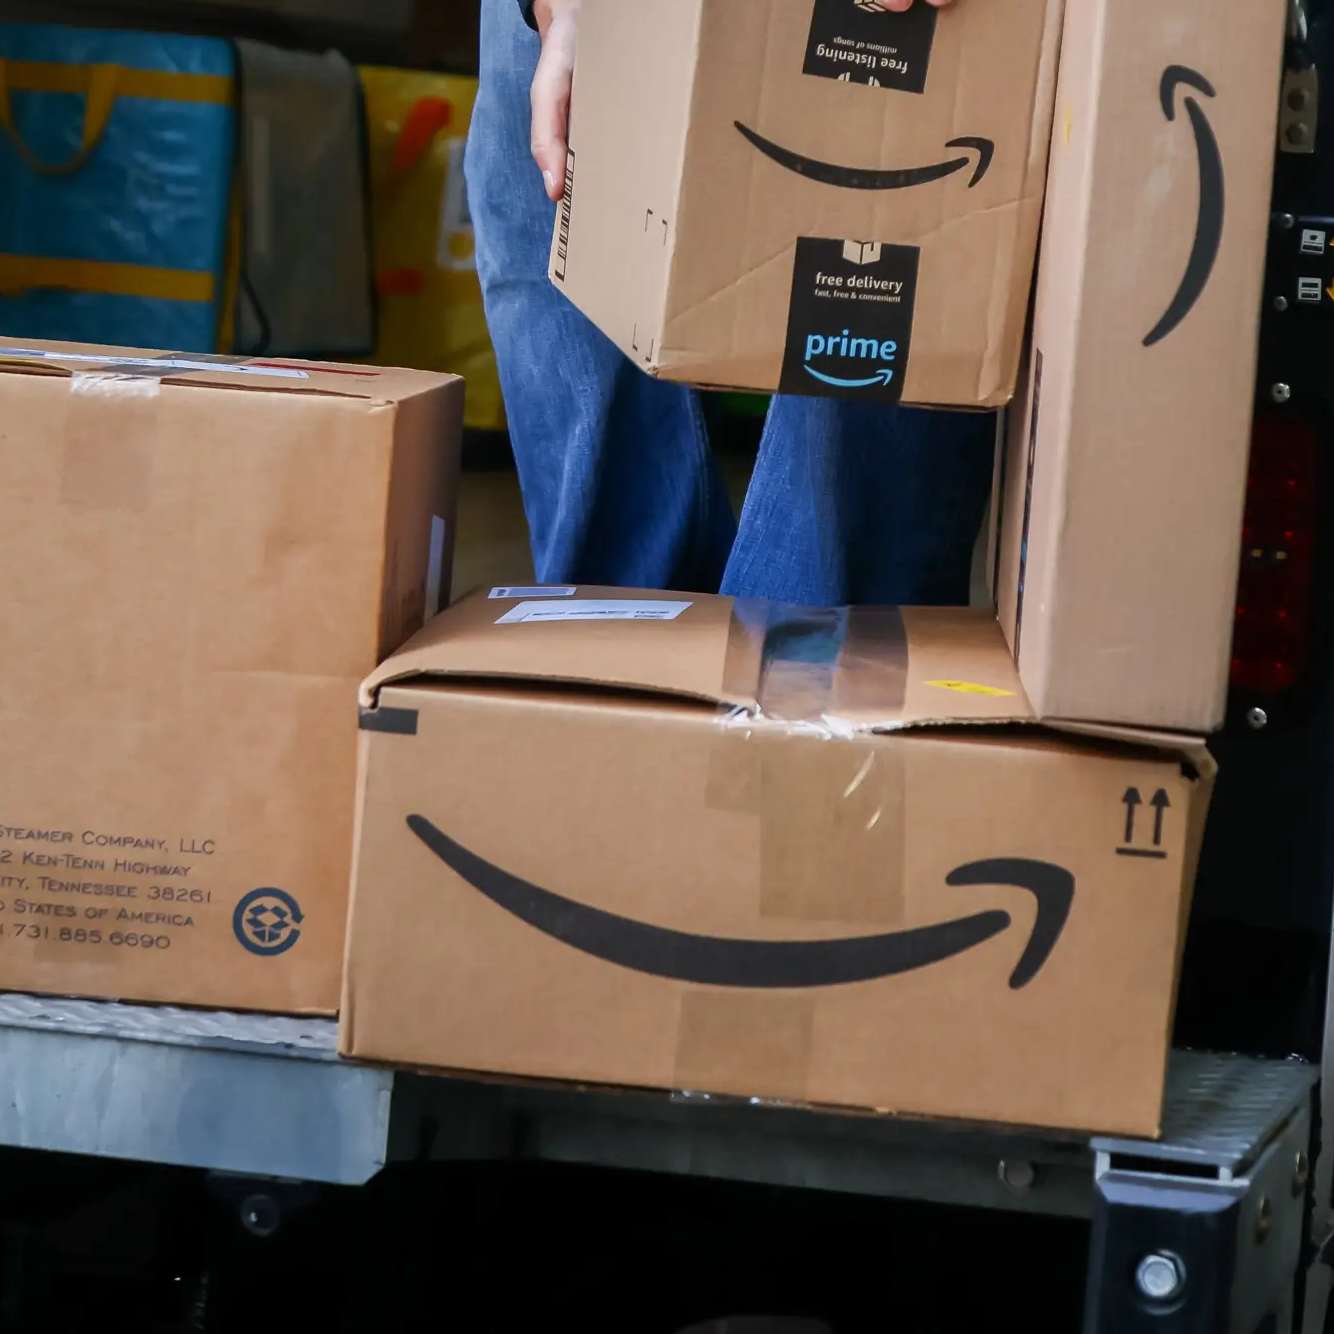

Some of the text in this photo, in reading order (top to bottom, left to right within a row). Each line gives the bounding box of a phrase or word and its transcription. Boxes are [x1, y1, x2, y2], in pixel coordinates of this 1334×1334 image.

[816, 44, 908, 74] free listening
[833, 36, 898, 54] millions of songs
[814, 288, 832, 298] fast,
[833, 289, 849, 299] free
[858, 293, 901, 303] convenient
[815, 271, 903, 294] free delivery
[804, 328, 897, 361] prime
[179, 837, 216, 855] LLC
[21, 850, 105, 871] KEN-TENN
[114, 858, 191, 878] HIGHWAY
[38, 876, 138, 899] TENNESSEE
[147, 885, 212, 904] 38261
[14, 898, 77, 919] STATES
[84, 907, 107, 921] OF
[116, 908, 195, 928] AMERICA
